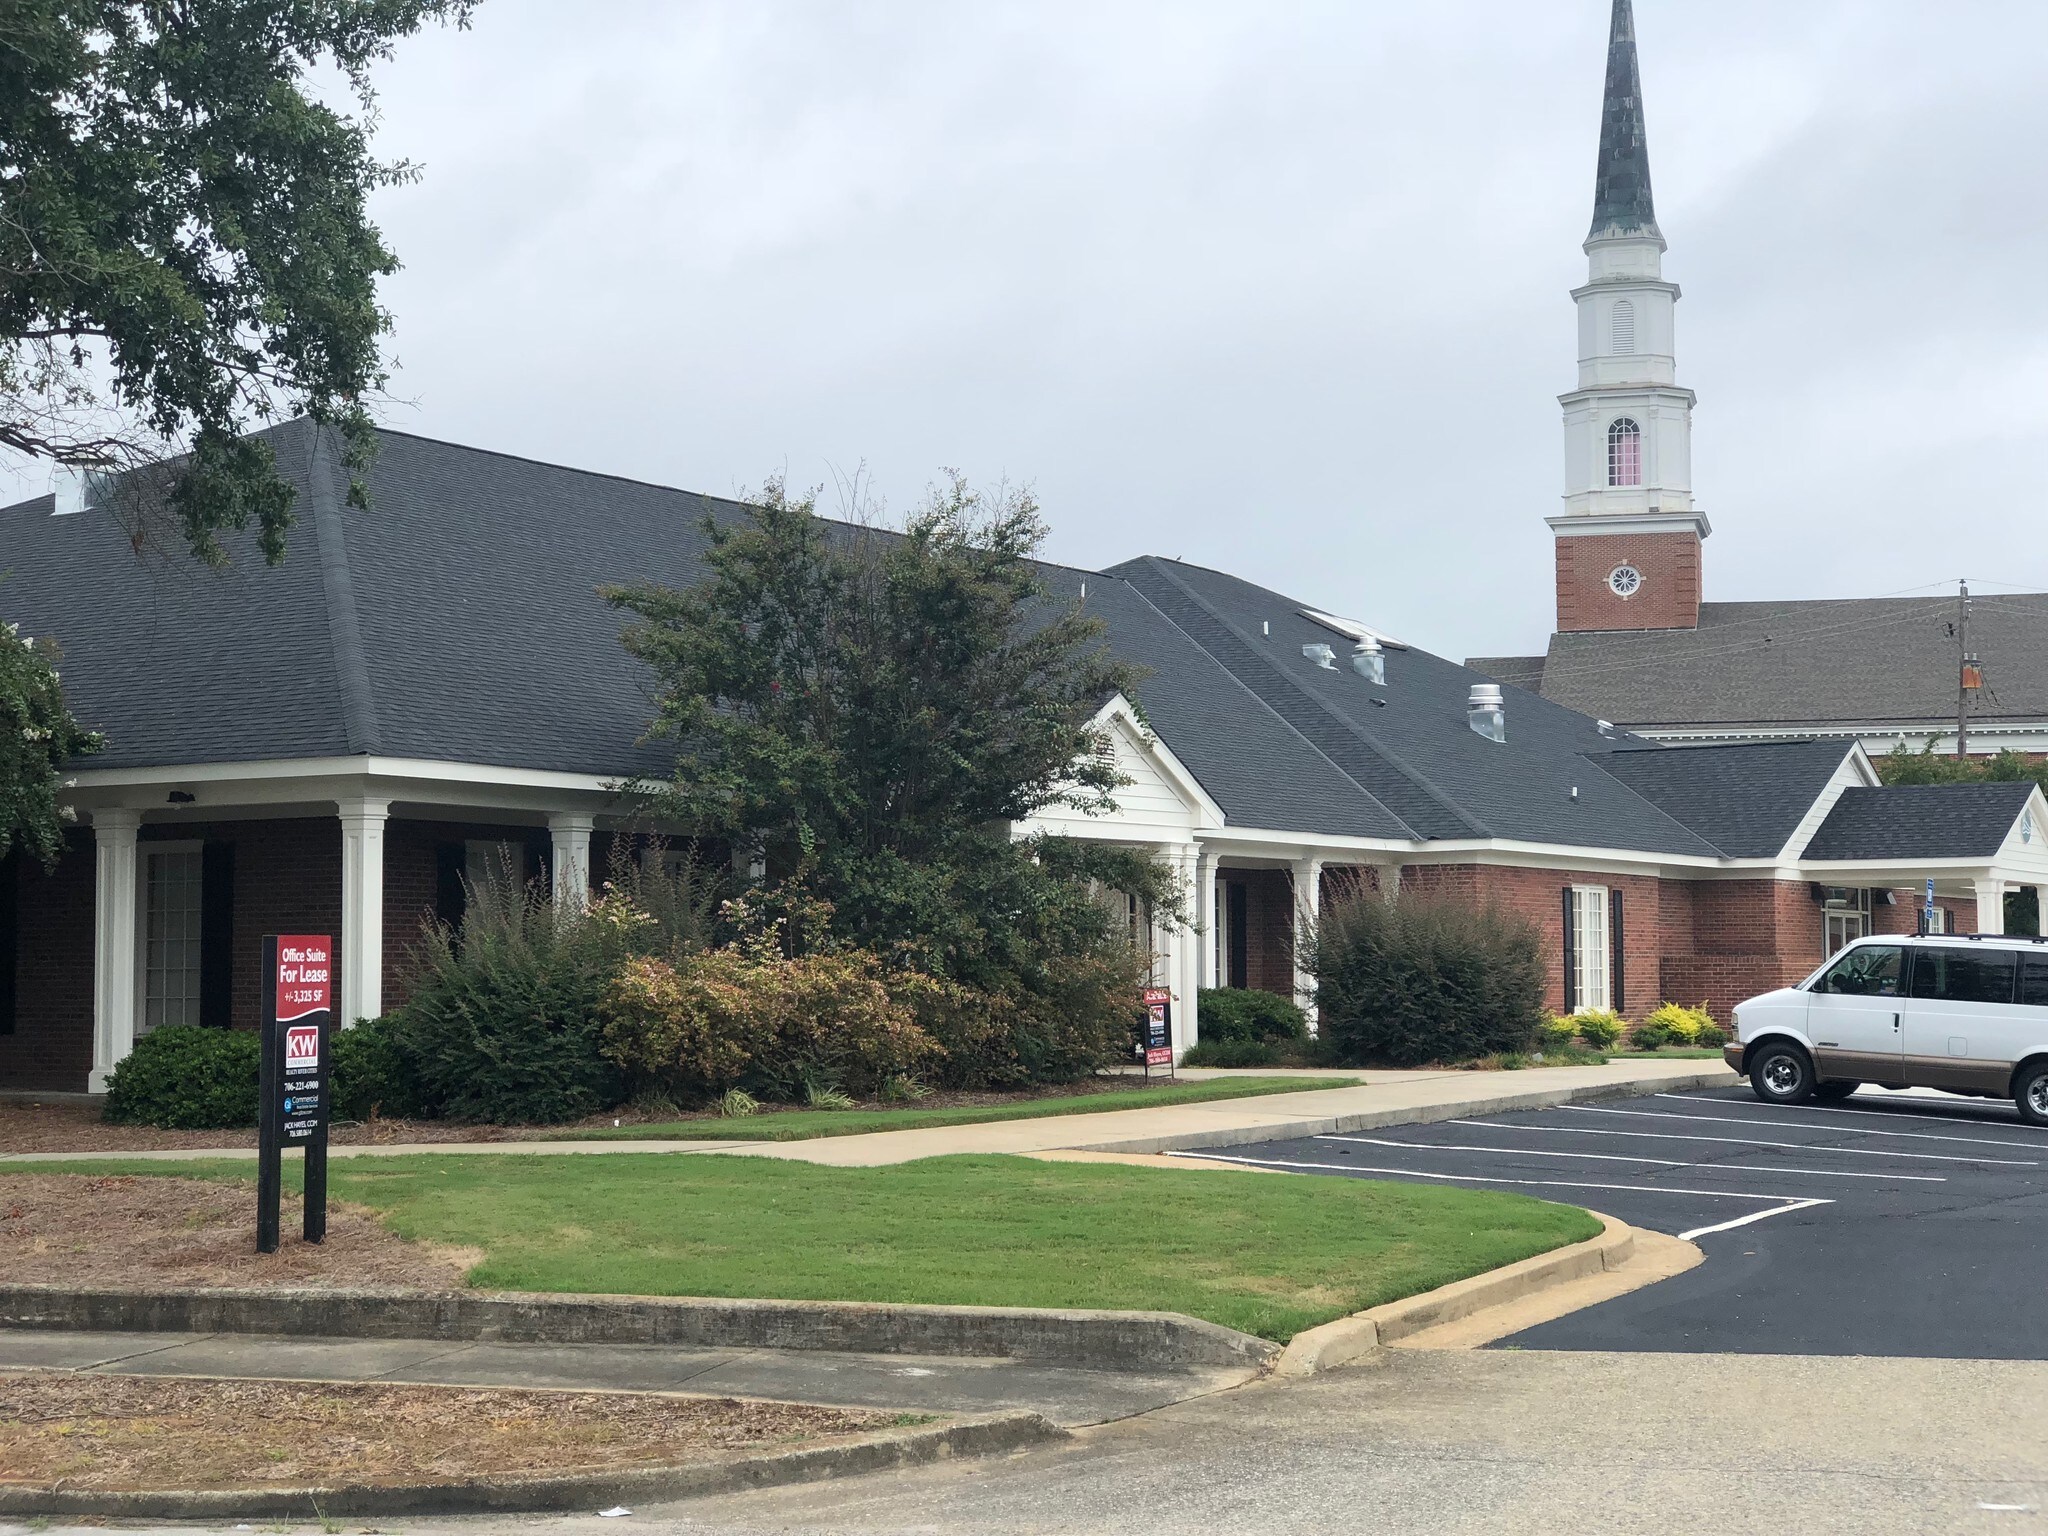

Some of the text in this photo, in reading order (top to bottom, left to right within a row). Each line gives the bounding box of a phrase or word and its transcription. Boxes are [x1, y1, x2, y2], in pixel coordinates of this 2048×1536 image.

[282, 948, 326, 962] Office Suite
[280, 965, 328, 983] For Lease
[314, 990, 323, 1001] SF
[288, 1035, 316, 1057] KW
[284, 1081, 318, 1091] 706-221-6900
[292, 1095, 318, 1103] Commercial
